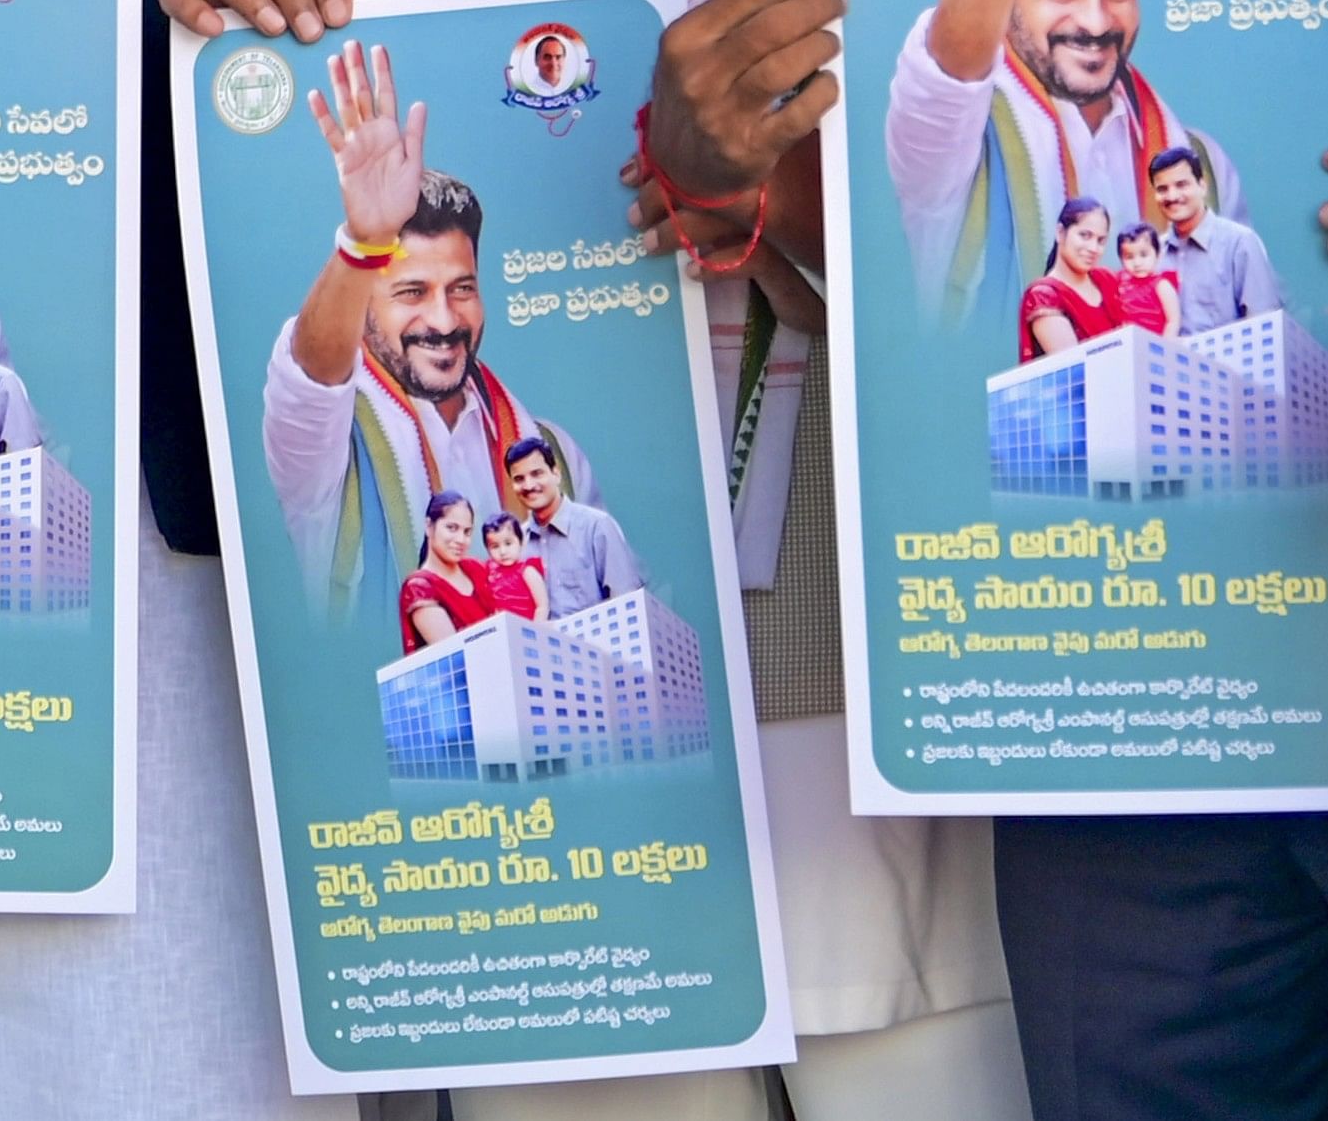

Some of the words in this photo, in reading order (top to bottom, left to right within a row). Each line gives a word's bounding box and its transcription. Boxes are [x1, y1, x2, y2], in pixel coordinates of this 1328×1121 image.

[6, 104, 87, 133] సేవలో
[502, 249, 566, 282] ప్రజల
[570, 232, 648, 269] సేవలో
[507, 292, 560, 325] ప్రజా
[566, 282, 668, 321] ప్రభుత్వం
[895, 523, 999, 558] రాజీవ్
[1009, 519, 1166, 569] ఆరోగ్యశ్రీ
[898, 576, 965, 622] వైద్య
[974, 576, 1092, 608] సాయం
[1102, 576, 1166, 607] రూ.
[1177, 573, 1215, 606] 10
[1225, 570, 1325, 614] లక్షలు
[899, 631, 960, 658] ఆరోగ్య
[964, 633, 1048, 651] తెలంగాణ
[1053, 632, 1089, 656] వైపు
[1093, 628, 1138, 650] మరో
[1143, 629, 1206, 649] అడుగు
[14, 817, 62, 832] అమలు
[307, 810, 402, 848] రాజీవ్
[410, 796, 554, 847] ఆరోగ్యశ్రీ
[313, 864, 377, 906] వైద్య
[382, 858, 490, 892] సాయం
[498, 853, 558, 884] రూ.
[567, 846, 603, 879] 10
[611, 840, 706, 882] లక్షలు
[320, 915, 375, 941] ఆరోగ్య
[377, 915, 453, 933] తెలంగాణ
[457, 910, 491, 934] వైపు
[494, 903, 536, 926] మరో
[539, 902, 598, 923] అడుగు
